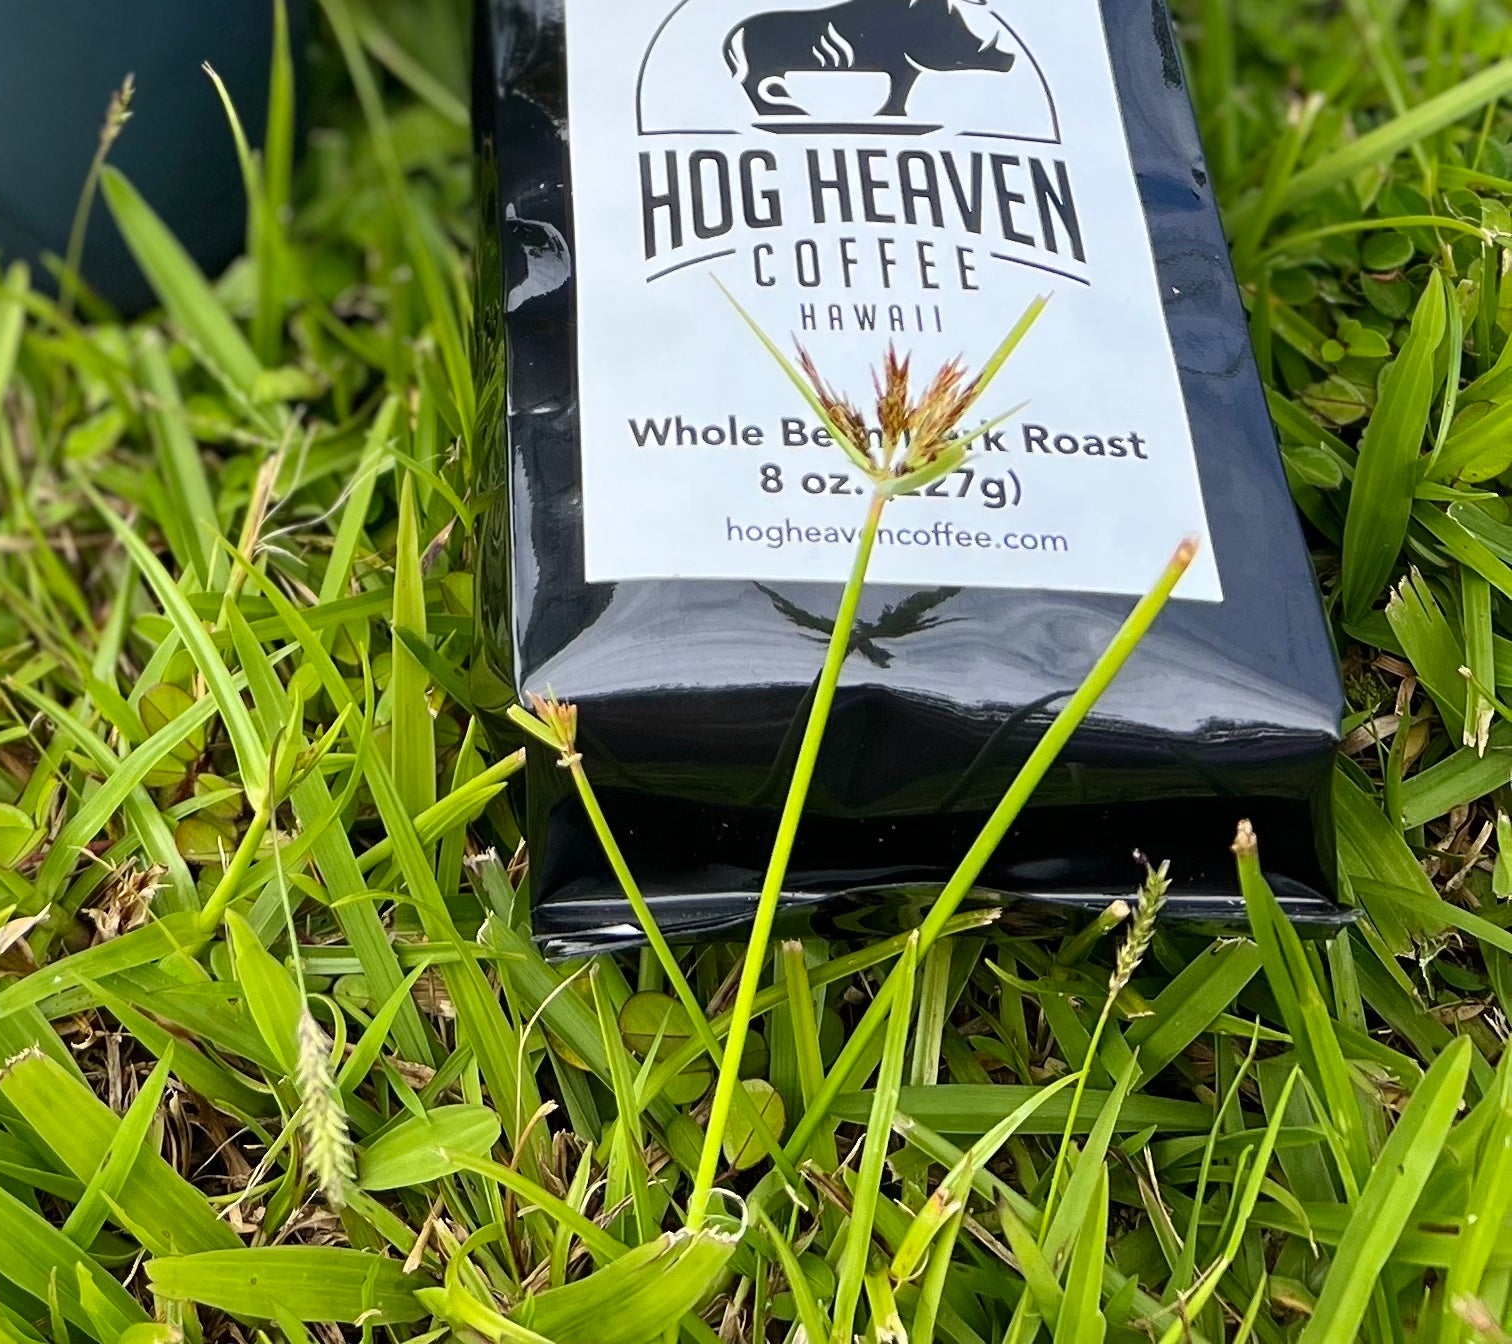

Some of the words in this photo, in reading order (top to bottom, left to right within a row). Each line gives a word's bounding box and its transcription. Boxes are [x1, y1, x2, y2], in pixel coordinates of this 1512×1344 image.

[638, 148, 783, 260] HOG
[805, 148, 1087, 265] HEAVEN
[752, 237, 979, 291] COFFEE
[799, 303, 942, 333] HAWAII
[628, 415, 764, 448] Whole
[781, 417, 884, 448] Ben
[1021, 423, 1149, 460] Roast
[759, 463, 784, 494] 8
[801, 470, 864, 496] oz.
[726, 516, 1069, 551] hogheavncoffee.com
